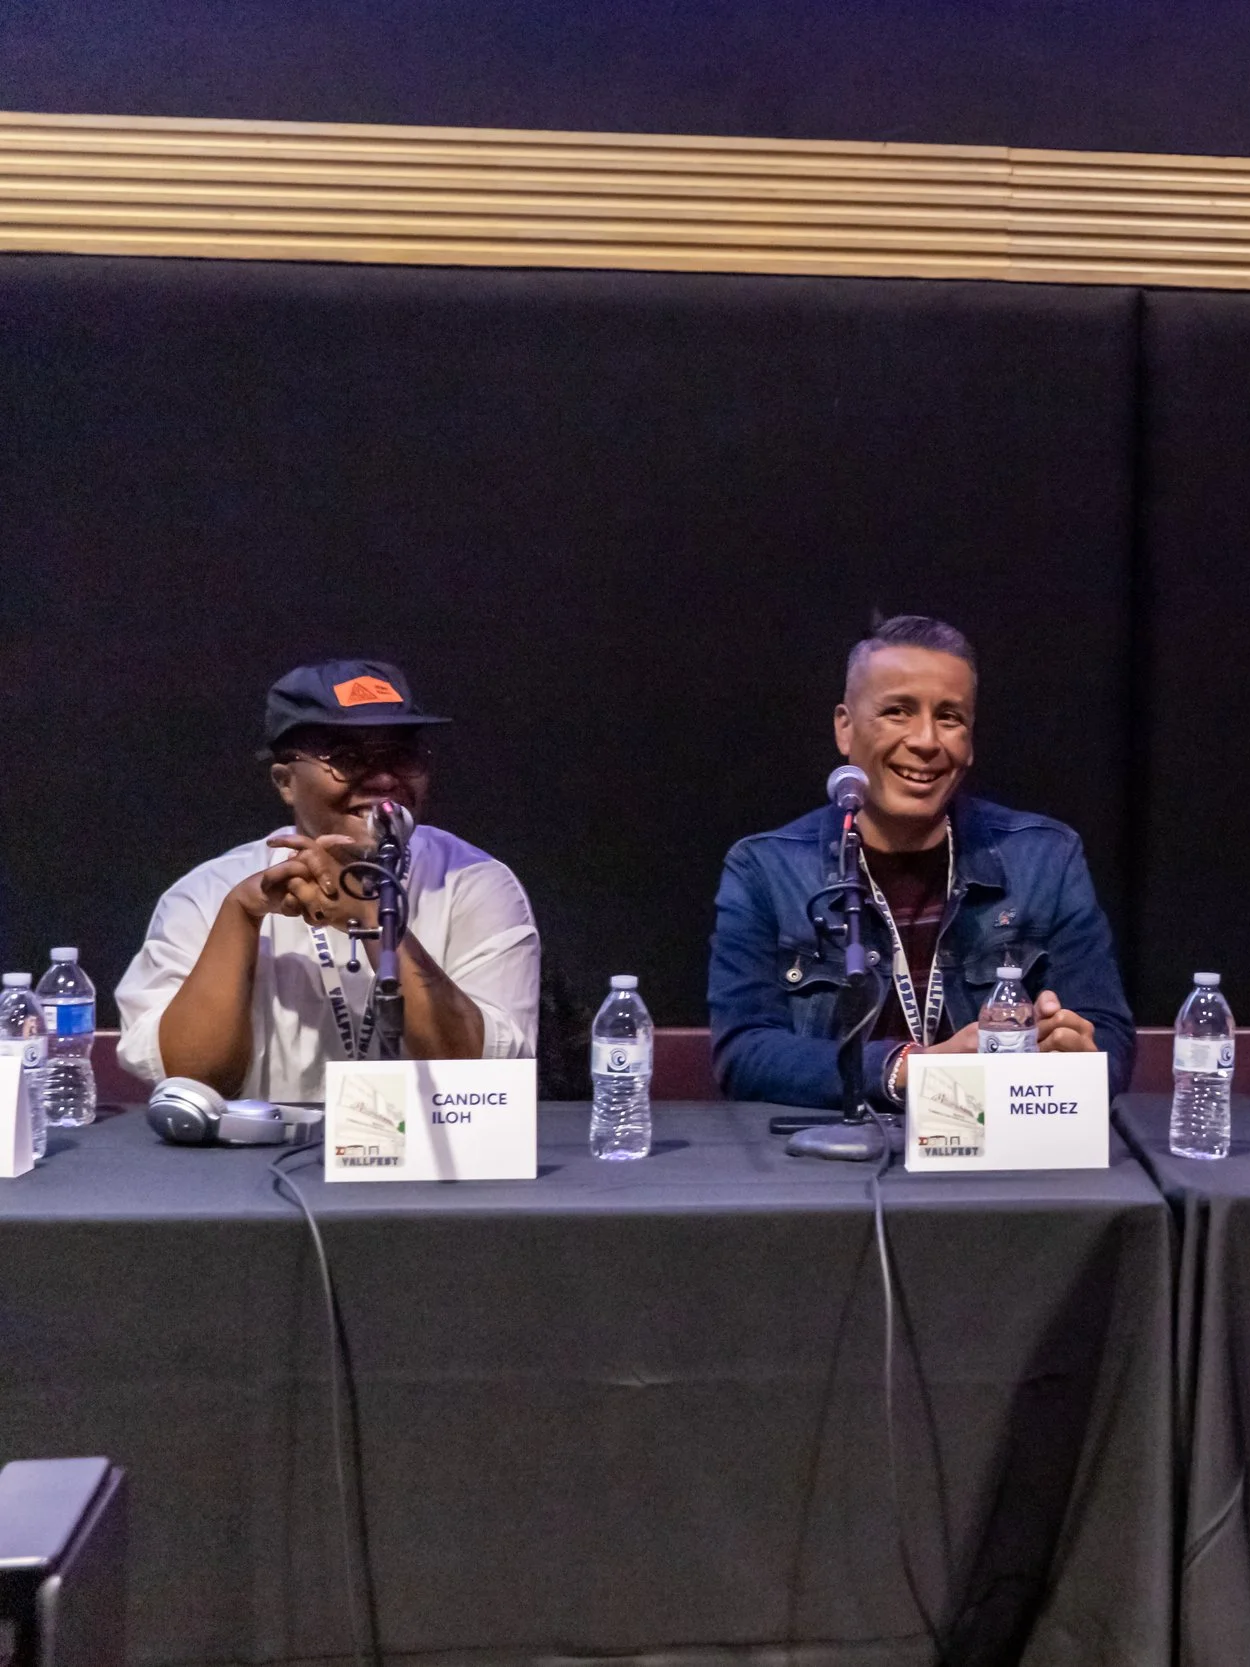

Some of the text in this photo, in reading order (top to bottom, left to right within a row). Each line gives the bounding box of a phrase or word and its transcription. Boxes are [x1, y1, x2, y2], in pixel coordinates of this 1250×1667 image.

[1010, 1085, 1054, 1097] MATT
[432, 1093, 507, 1106] CANDICE
[1010, 1103, 1078, 1115] MENDEZ
[432, 1111, 472, 1124] ILOH
[925, 1147, 979, 1156] YALLFEST
[342, 1157, 399, 1166] YALLFEST
